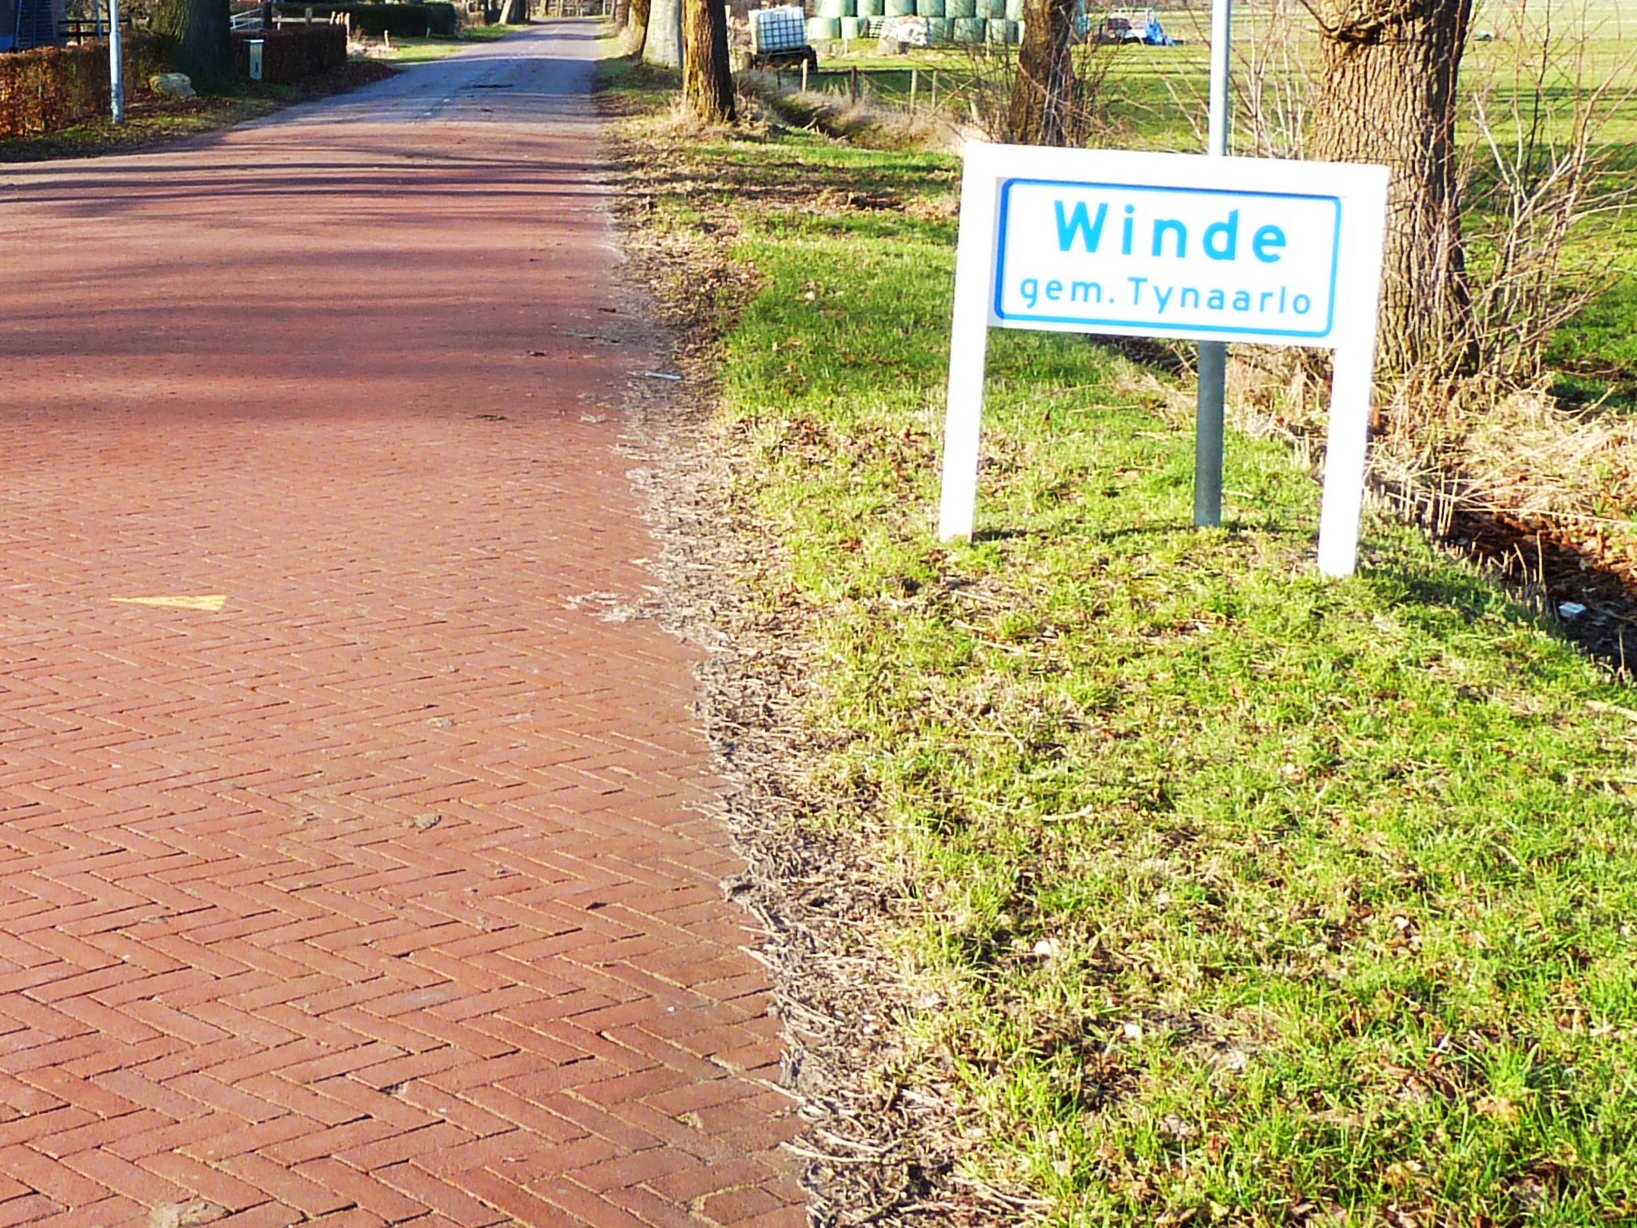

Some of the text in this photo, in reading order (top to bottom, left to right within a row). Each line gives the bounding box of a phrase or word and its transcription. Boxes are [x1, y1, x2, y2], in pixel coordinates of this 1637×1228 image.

[1053, 199, 1287, 264] Winde
[1019, 276, 1312, 315] gem. Tynaarlo
